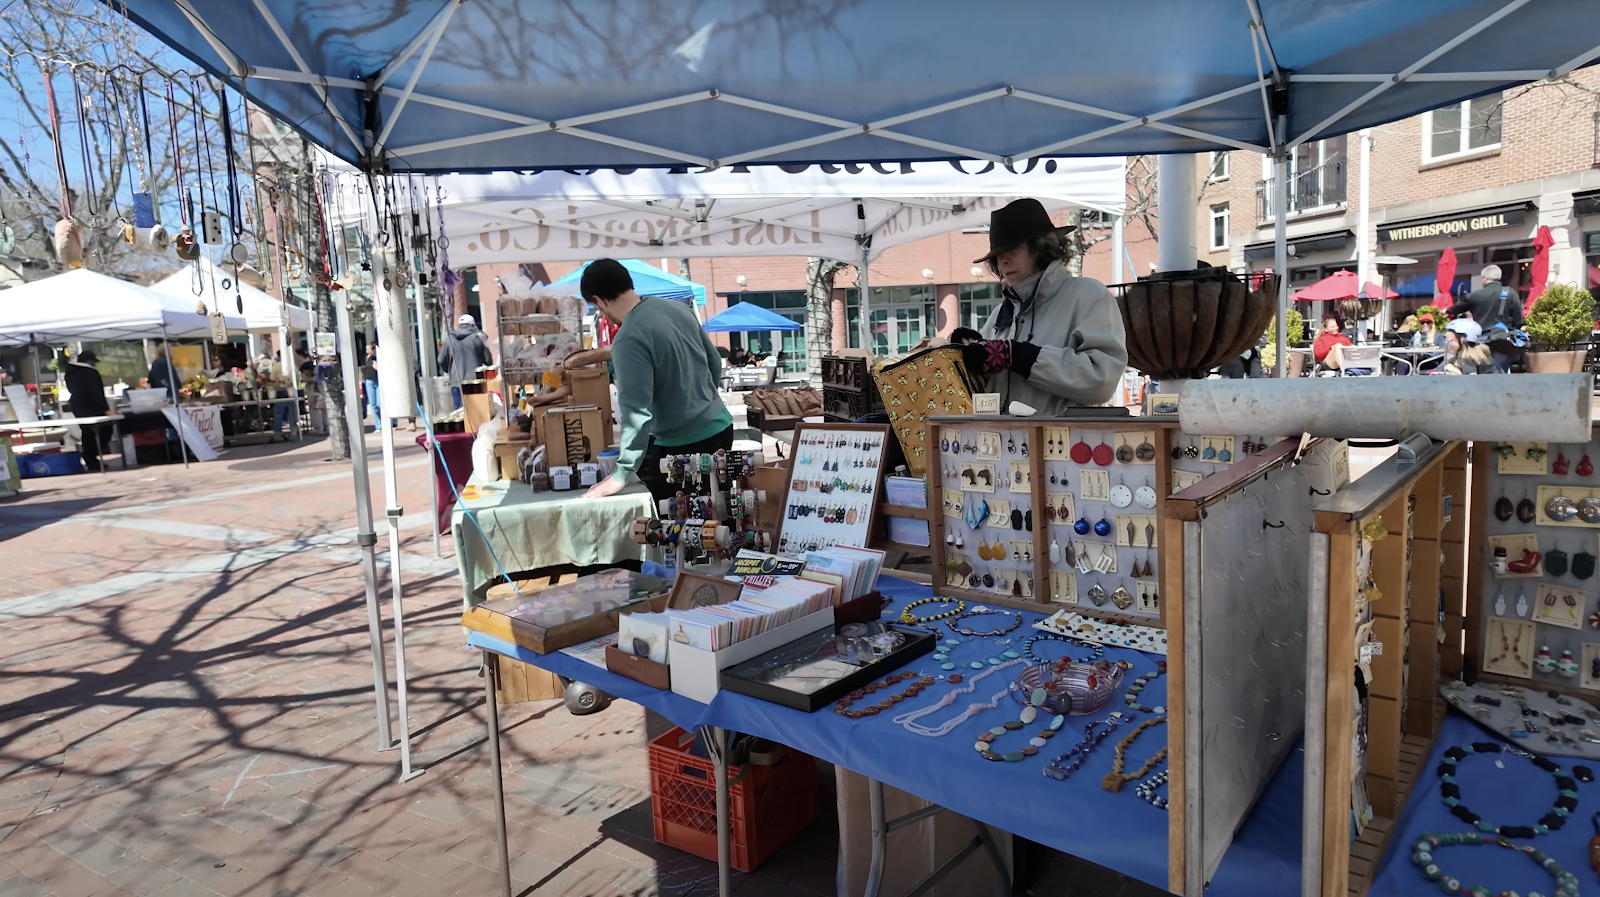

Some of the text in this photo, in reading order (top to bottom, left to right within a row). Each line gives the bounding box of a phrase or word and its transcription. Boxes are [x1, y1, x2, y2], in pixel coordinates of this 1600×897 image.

[1389, 214, 1508, 241] WITHERSPOON GRILL
[566, 419, 583, 463] SHARR
[744, 575, 774, 588] PHILLIES
